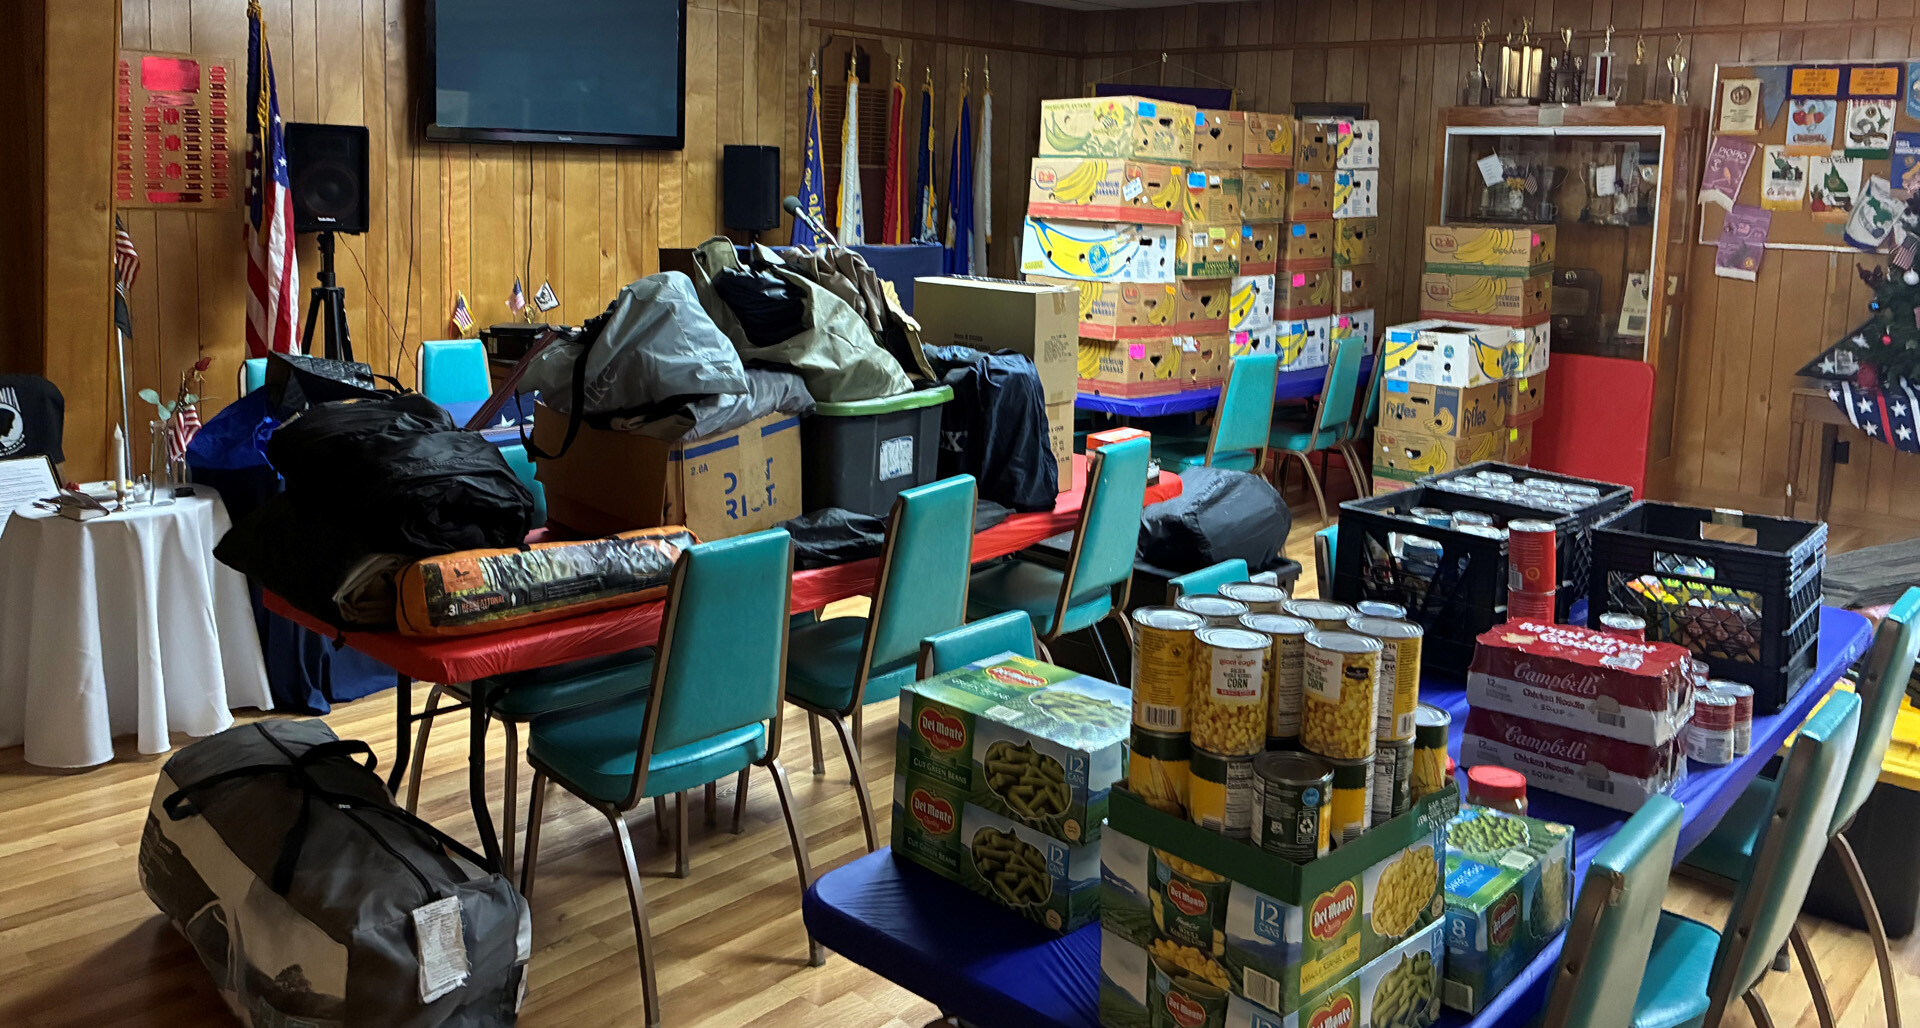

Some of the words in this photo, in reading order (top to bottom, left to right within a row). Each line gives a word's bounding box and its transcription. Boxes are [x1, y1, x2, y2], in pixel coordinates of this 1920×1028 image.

[1227, 679, 1248, 689] CORN
[1514, 661, 1600, 696] Campbell's
[1523, 688, 1554, 704] Chicken
[1554, 695, 1586, 711] Noodle
[1539, 703, 1566, 716] SOUP
[921, 716, 936, 732] Del
[936, 719, 964, 742] Monte
[1504, 724, 1588, 761] Campbell's
[913, 757, 926, 769] CUT
[926, 762, 947, 776] GREEN
[948, 769, 967, 785] BEANS
[1068, 754, 1084, 775] 12
[1513, 752, 1544, 769] Chicken
[1544, 760, 1575, 776] Noodle
[1531, 768, 1555, 781] SOUP
[1067, 772, 1085, 785] CANS
[914, 796, 927, 812] Del
[927, 801, 953, 825] Monte
[1049, 845, 1064, 864] 12
[1170, 886, 1182, 898] Del
[1182, 891, 1206, 909] Monte
[1259, 901, 1280, 927] 12
[1313, 910, 1328, 929] Del
[1328, 894, 1354, 918] Monte
[1258, 922, 1280, 938] CANS
[1452, 919, 1466, 938] 8
[1168, 998, 1180, 1010] Del
[1181, 1003, 1204, 1021] Monte
